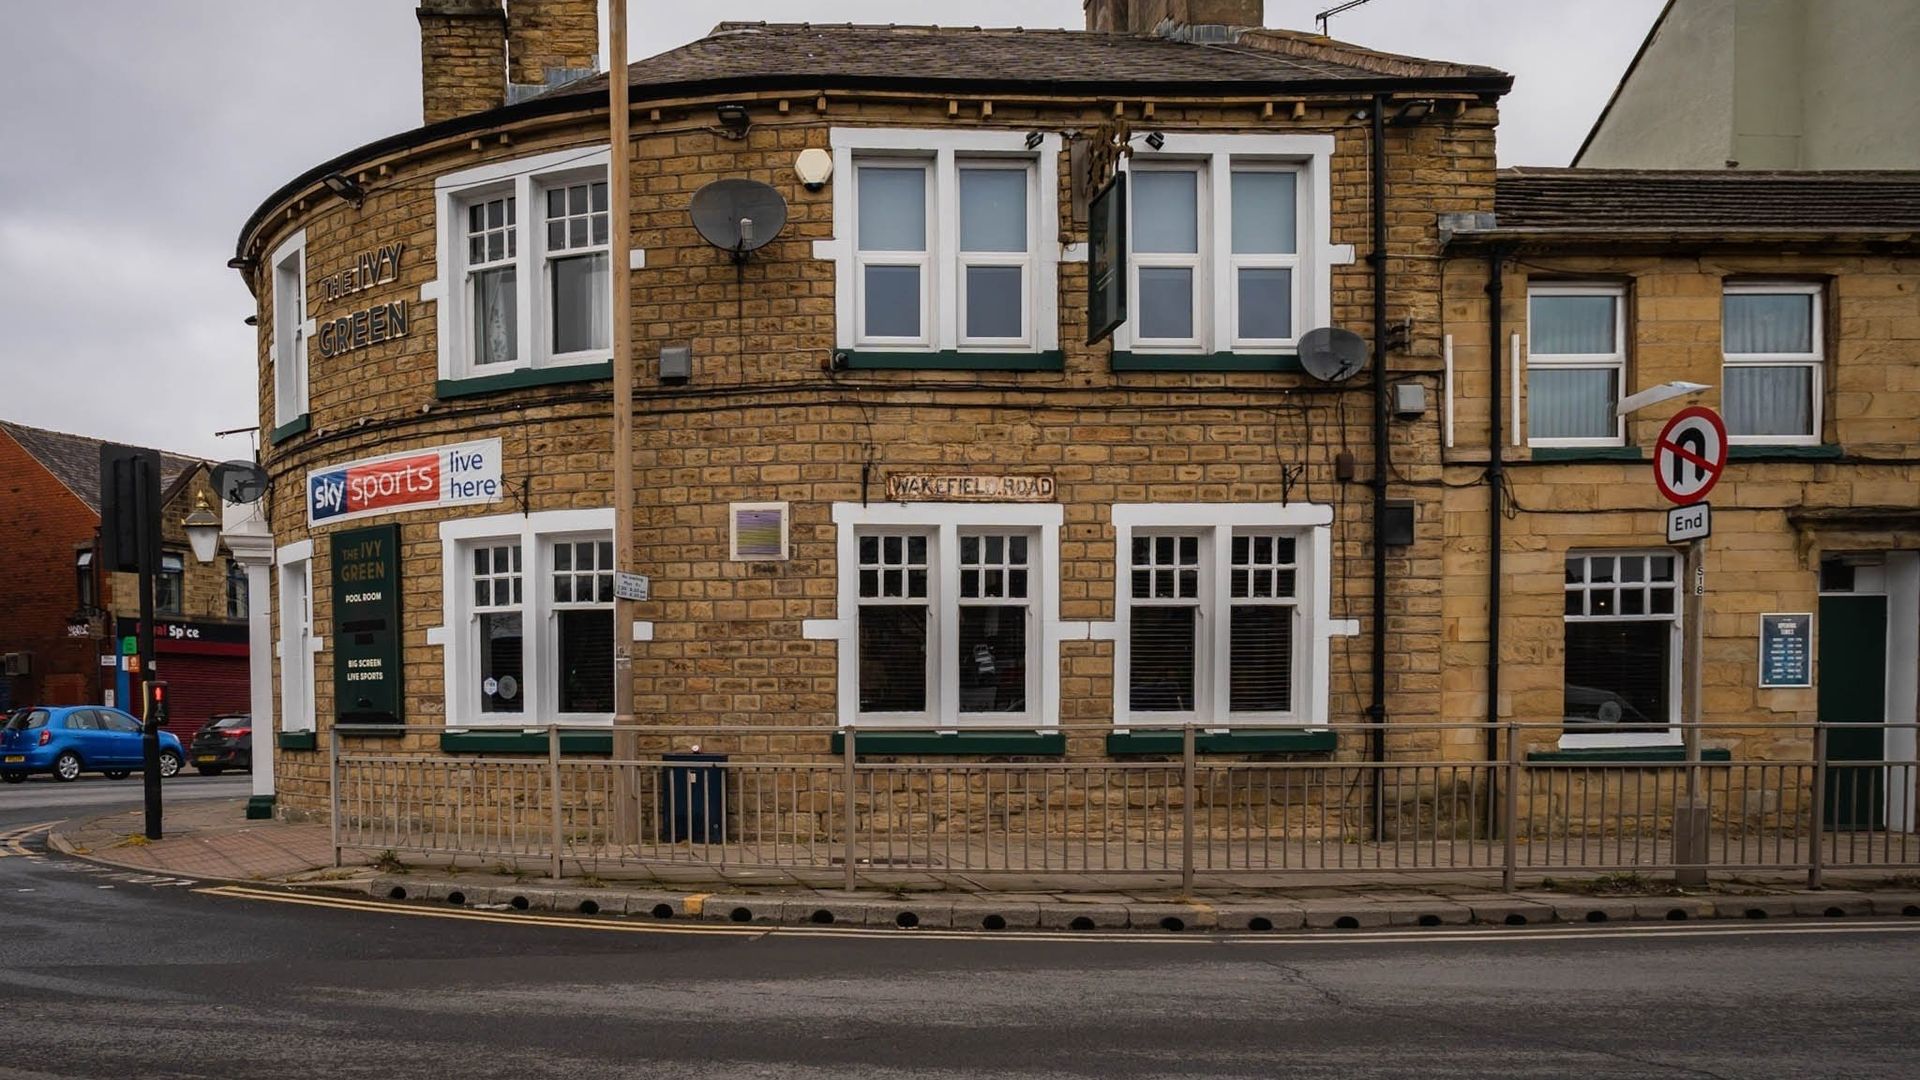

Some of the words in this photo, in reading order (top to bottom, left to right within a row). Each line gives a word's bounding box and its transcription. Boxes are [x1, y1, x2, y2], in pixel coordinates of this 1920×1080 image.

[321, 268, 352, 301] THE
[357, 241, 403, 290] IVY
[318, 299, 409, 358] GREEN
[450, 451, 483, 473] live
[314, 478, 344, 512] sky
[351, 465, 433, 507] sports
[450, 478, 496, 499] here
[1003, 477, 1052, 496] ROAD
[1675, 513, 1702, 531] End
[342, 548, 359, 561] THE
[361, 540, 382, 558] IVY
[341, 562, 385, 581] GREEN
[345, 593, 362, 604] POOL
[362, 592, 382, 602] ROOM
[348, 659, 358, 668] BIG
[358, 658, 382, 668] SCREEN
[347, 672, 359, 682] LIVE
[360, 671, 383, 681] SPORTS
